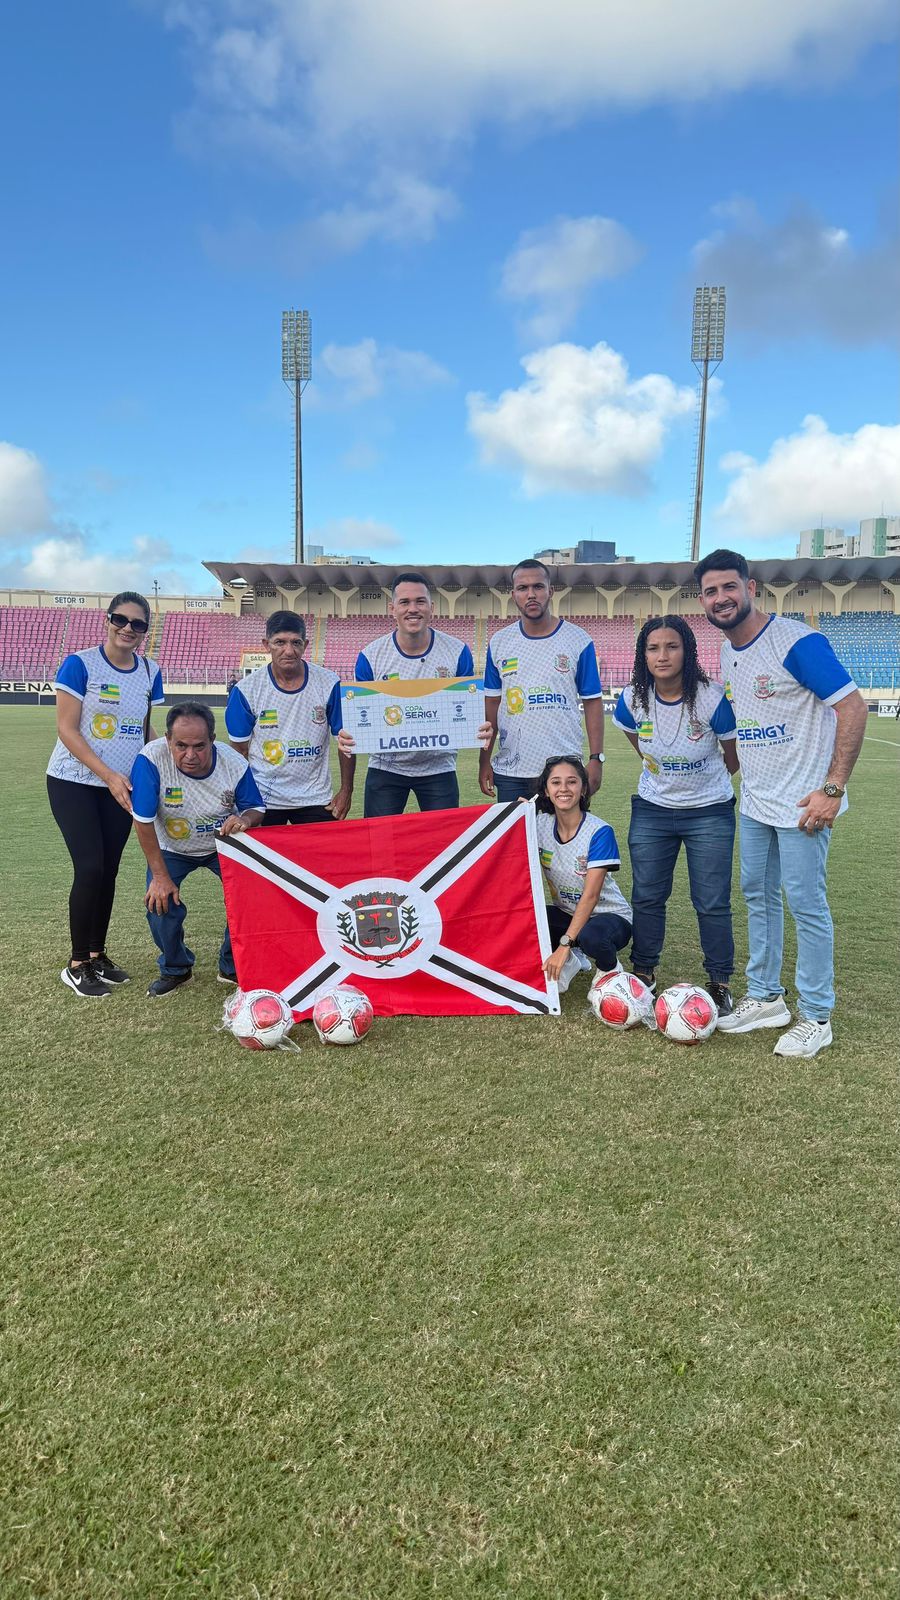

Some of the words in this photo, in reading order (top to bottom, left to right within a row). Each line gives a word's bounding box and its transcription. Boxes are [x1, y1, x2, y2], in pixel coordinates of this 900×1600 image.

[54, 596, 77, 604] SETOR
[528, 685, 553, 694] COPA
[404, 710, 438, 720] SERIGY
[737, 723, 787, 741] SERIGY
[287, 739, 312, 748] COPA
[379, 734, 450, 750] LAGARTO
[769, 736, 794, 746] AMADOR
[660, 755, 689, 763] COPA
